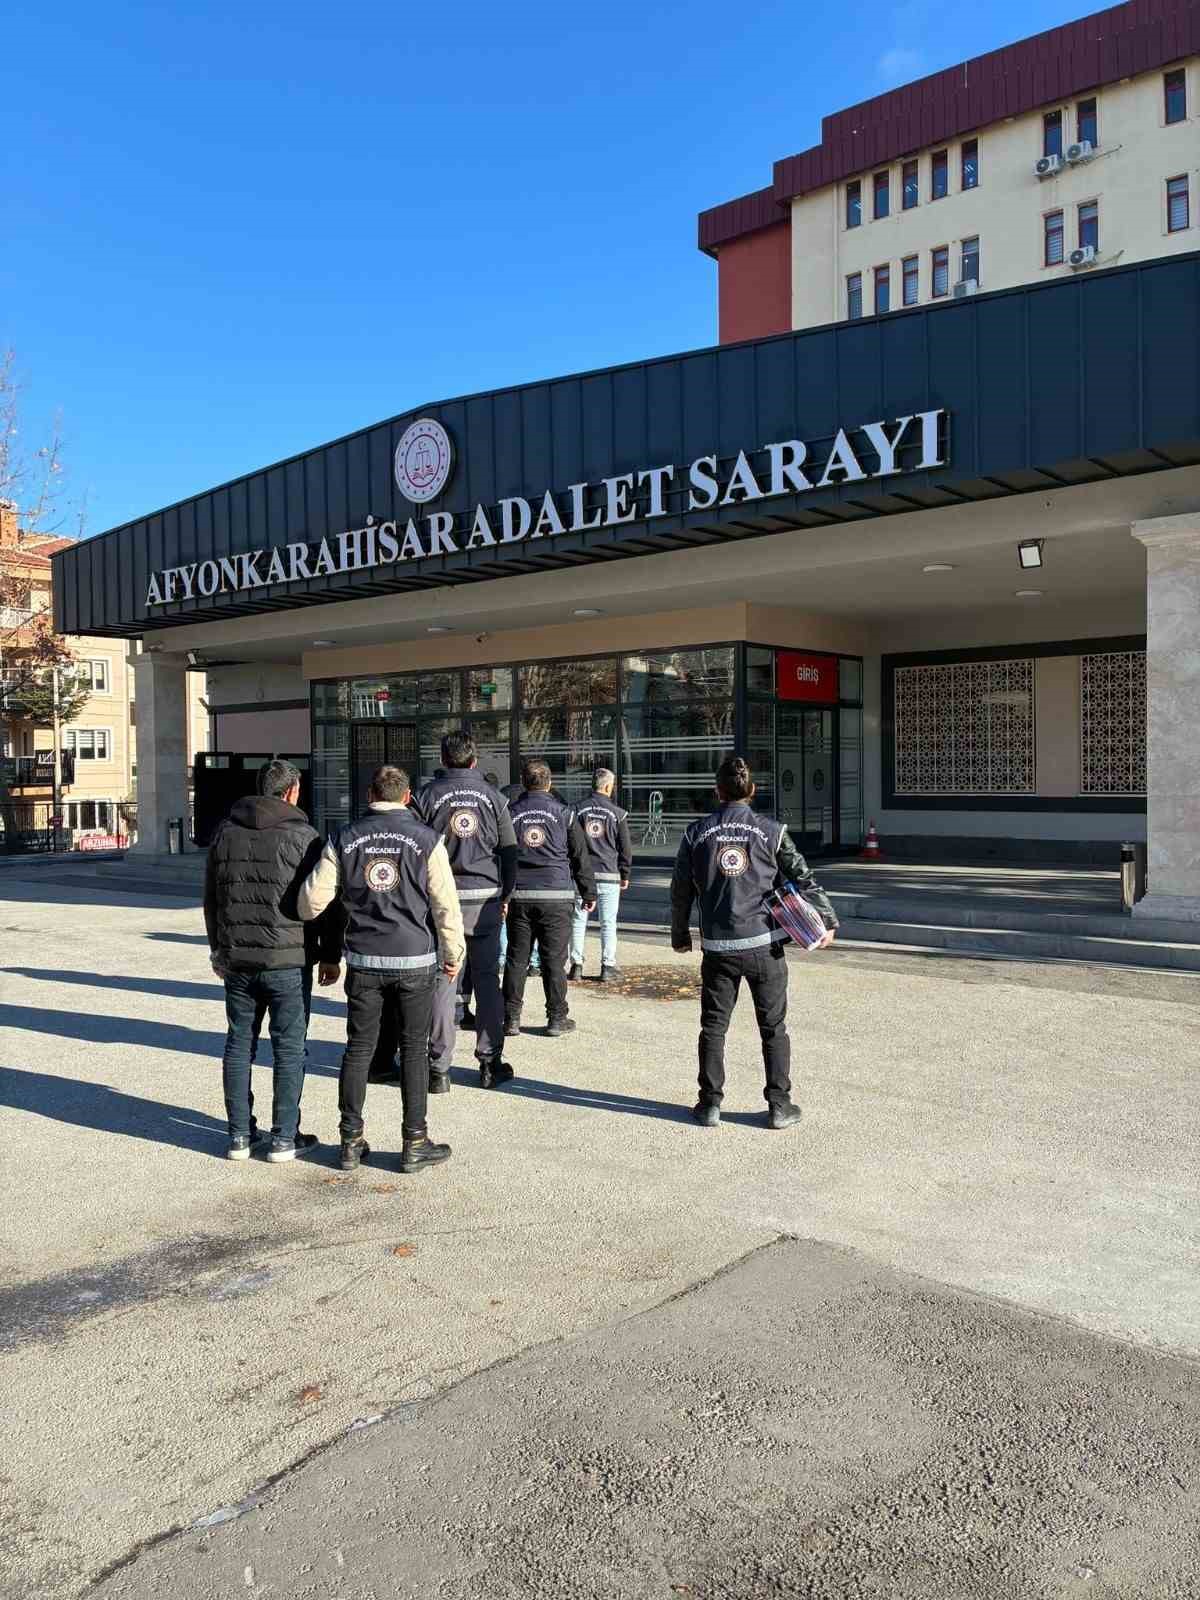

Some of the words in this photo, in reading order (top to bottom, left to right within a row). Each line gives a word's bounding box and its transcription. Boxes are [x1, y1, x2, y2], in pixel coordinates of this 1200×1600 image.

[145, 511, 458, 606] AFYONKARAHİSAR
[465, 464, 674, 550] ADALET
[688, 408, 945, 512] SARAYI
[796, 664, 819, 685] GİRİŞ
[364, 846, 401, 854] MÜCADELE
